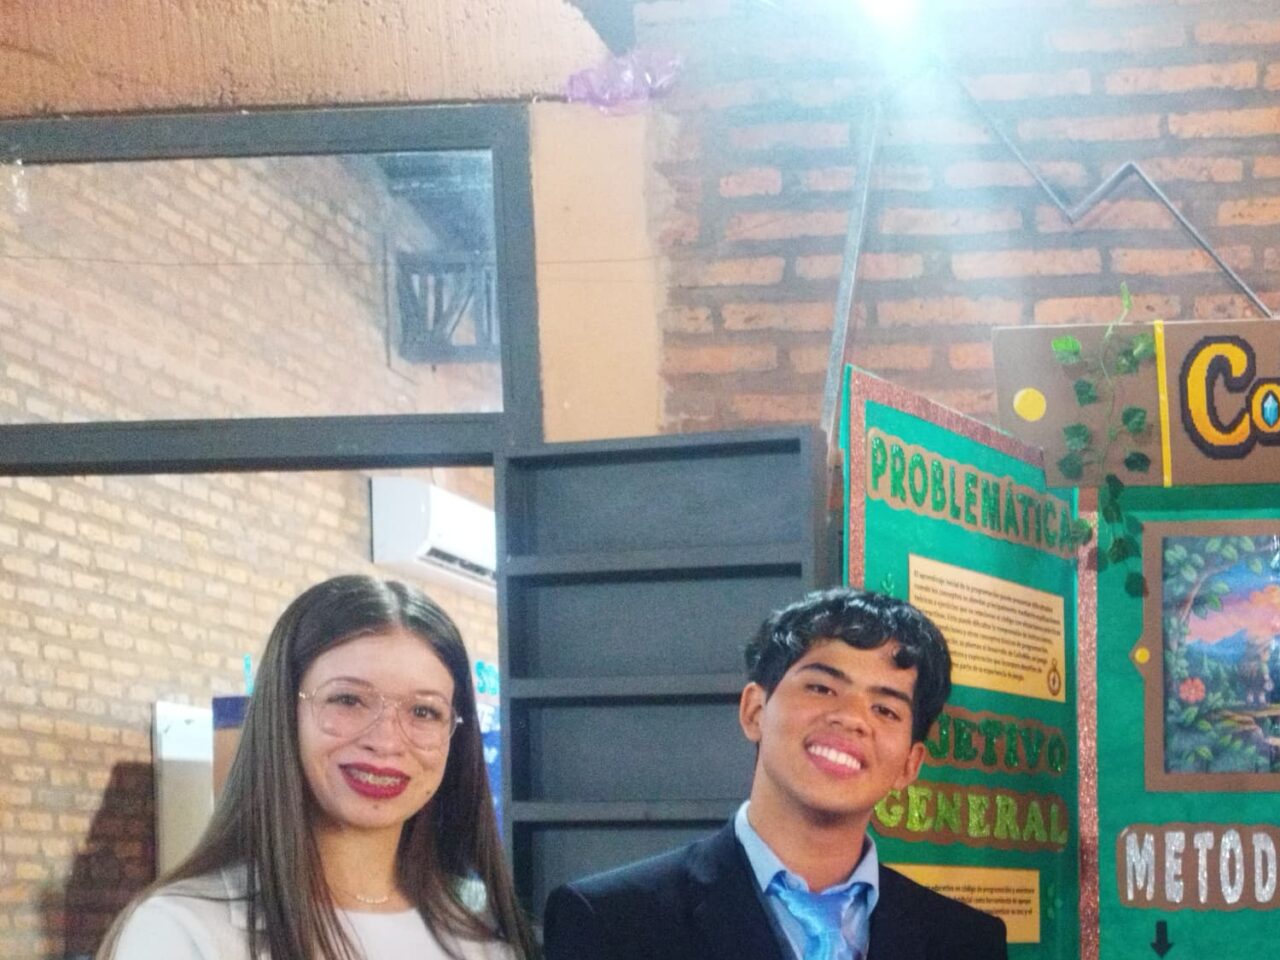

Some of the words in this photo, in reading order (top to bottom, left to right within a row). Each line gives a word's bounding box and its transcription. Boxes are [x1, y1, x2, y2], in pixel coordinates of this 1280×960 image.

[870, 436, 1074, 550] PROBLEMÁTICA
[925, 713, 1068, 773] JETIVO
[873, 785, 1068, 844] GENERAL
